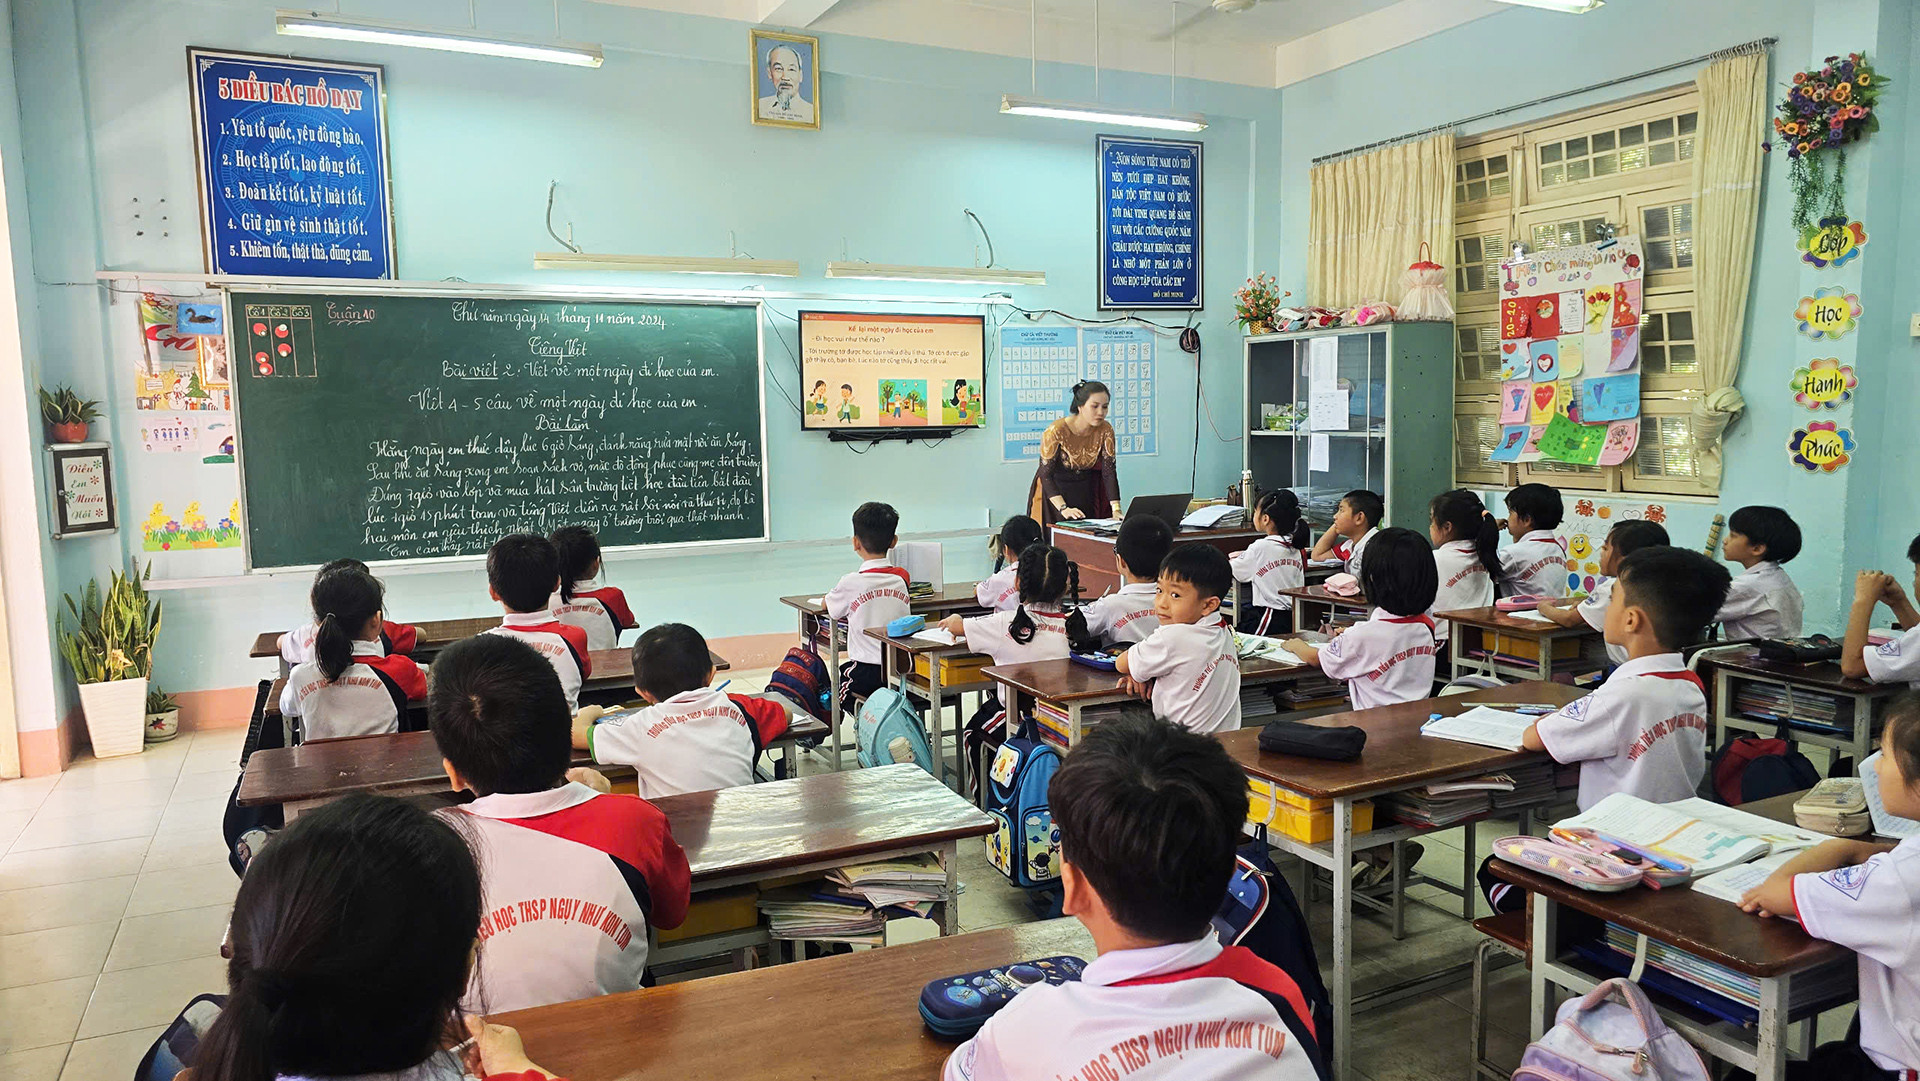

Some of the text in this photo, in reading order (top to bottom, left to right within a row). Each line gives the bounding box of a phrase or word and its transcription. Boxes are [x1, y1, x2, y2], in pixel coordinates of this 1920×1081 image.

[219, 78, 230, 99] 5
[271, 78, 304, 105] BÁC
[304, 77, 328, 106] HỒ
[329, 88, 362, 114] DẠY
[220, 117, 363, 148] 1. Yêu tổ quốc, yêu đồng bào.
[222, 150, 364, 177] 2. Học tập tốt, lao động tốt.
[225, 182, 366, 207] 3. Đoàn kết tốt, kỷ luật tốt.
[228, 218, 237, 229] 4.
[265, 213, 281, 235] gìn
[284, 216, 296, 235] vệ
[300, 216, 321, 233] sinh
[324, 217, 345, 237] thật
[348, 216, 368, 235] tốt.
[230, 239, 372, 264] 5. Khiêm tốn, thật thà, dũng cảm.
[326, 301, 376, 320] Tuần 10
[452, 300, 478, 321] Thứ
[481, 309, 504, 323] năm
[505, 308, 537, 331] ngày
[555, 305, 591, 332] tháng
[607, 312, 634, 324] năm
[1815, 305, 1842, 326] Học
[442, 360, 466, 378] Bài
[469, 353, 498, 377] viết
[523, 360, 548, 377] Viết
[551, 362, 571, 377] về
[574, 363, 601, 381] một
[603, 364, 634, 386] ngày
[639, 361, 653, 377] đi
[654, 356, 674, 380] học
[677, 359, 697, 377] của
[701, 368, 719, 377] em.
[1804, 373, 1843, 396] Hạnh
[408, 387, 443, 410] Viết
[448, 399, 457, 412] 4
[474, 398, 483, 410] 5
[486, 393, 512, 410] câu
[516, 389, 538, 409] về
[540, 390, 567, 412] một
[569, 393, 606, 419] ngày
[610, 389, 625, 409] đi
[627, 387, 652, 413] học
[657, 393, 678, 409] của
[1805, 433, 1840, 458] Phúc
[492, 897, 633, 952] HỌC THSP NGỤY NHƯ KON TUM
[1110, 1017, 1286, 1075] THSP NGỤY NHƯ KON TUM
